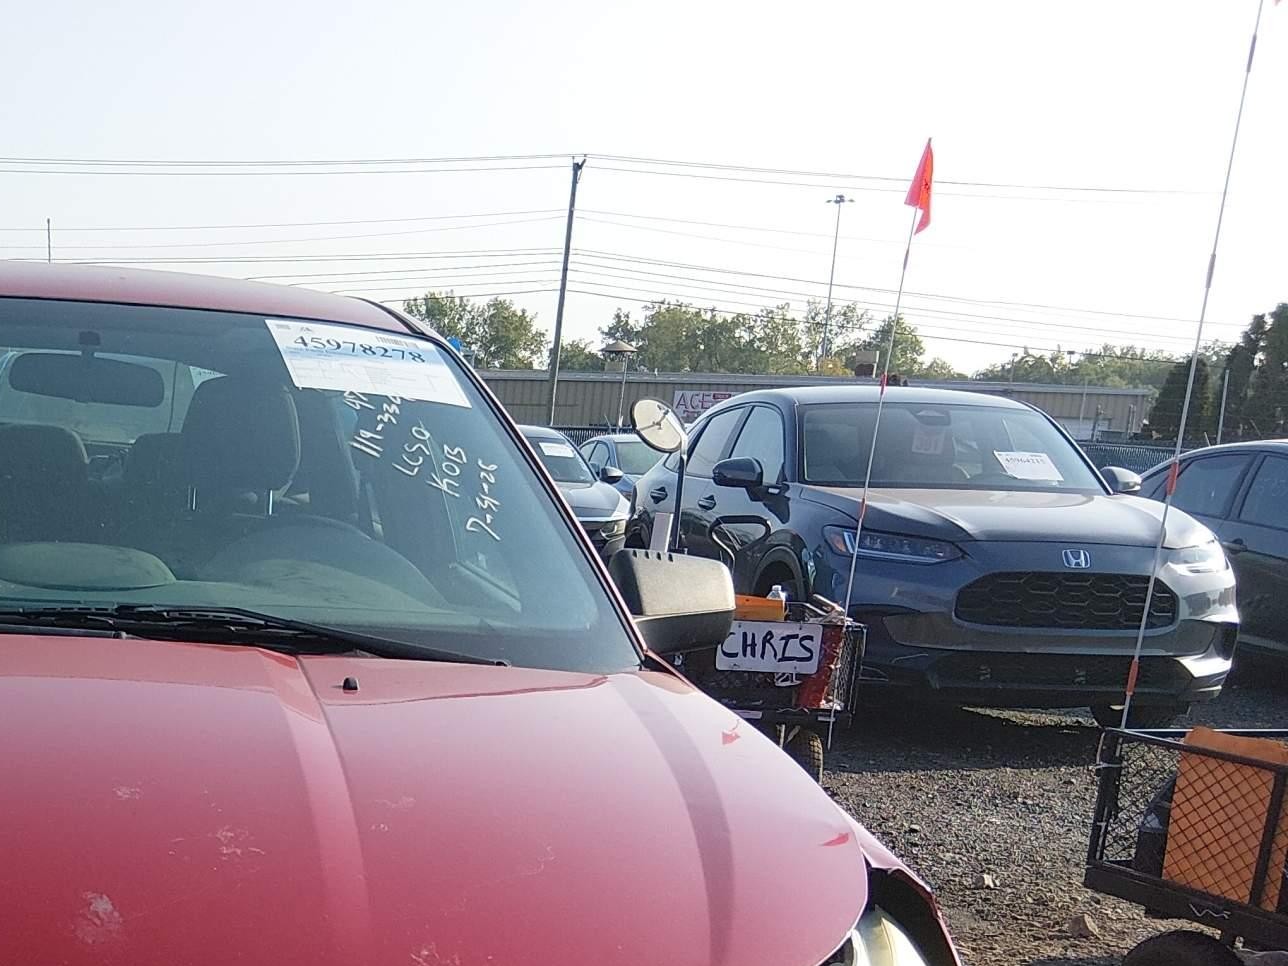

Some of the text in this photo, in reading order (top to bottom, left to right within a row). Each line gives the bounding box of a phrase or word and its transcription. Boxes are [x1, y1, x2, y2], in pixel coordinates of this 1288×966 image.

[293, 334, 426, 364] 45978278
[675, 392, 712, 410] ACE
[720, 630, 815, 663] CHRIS
